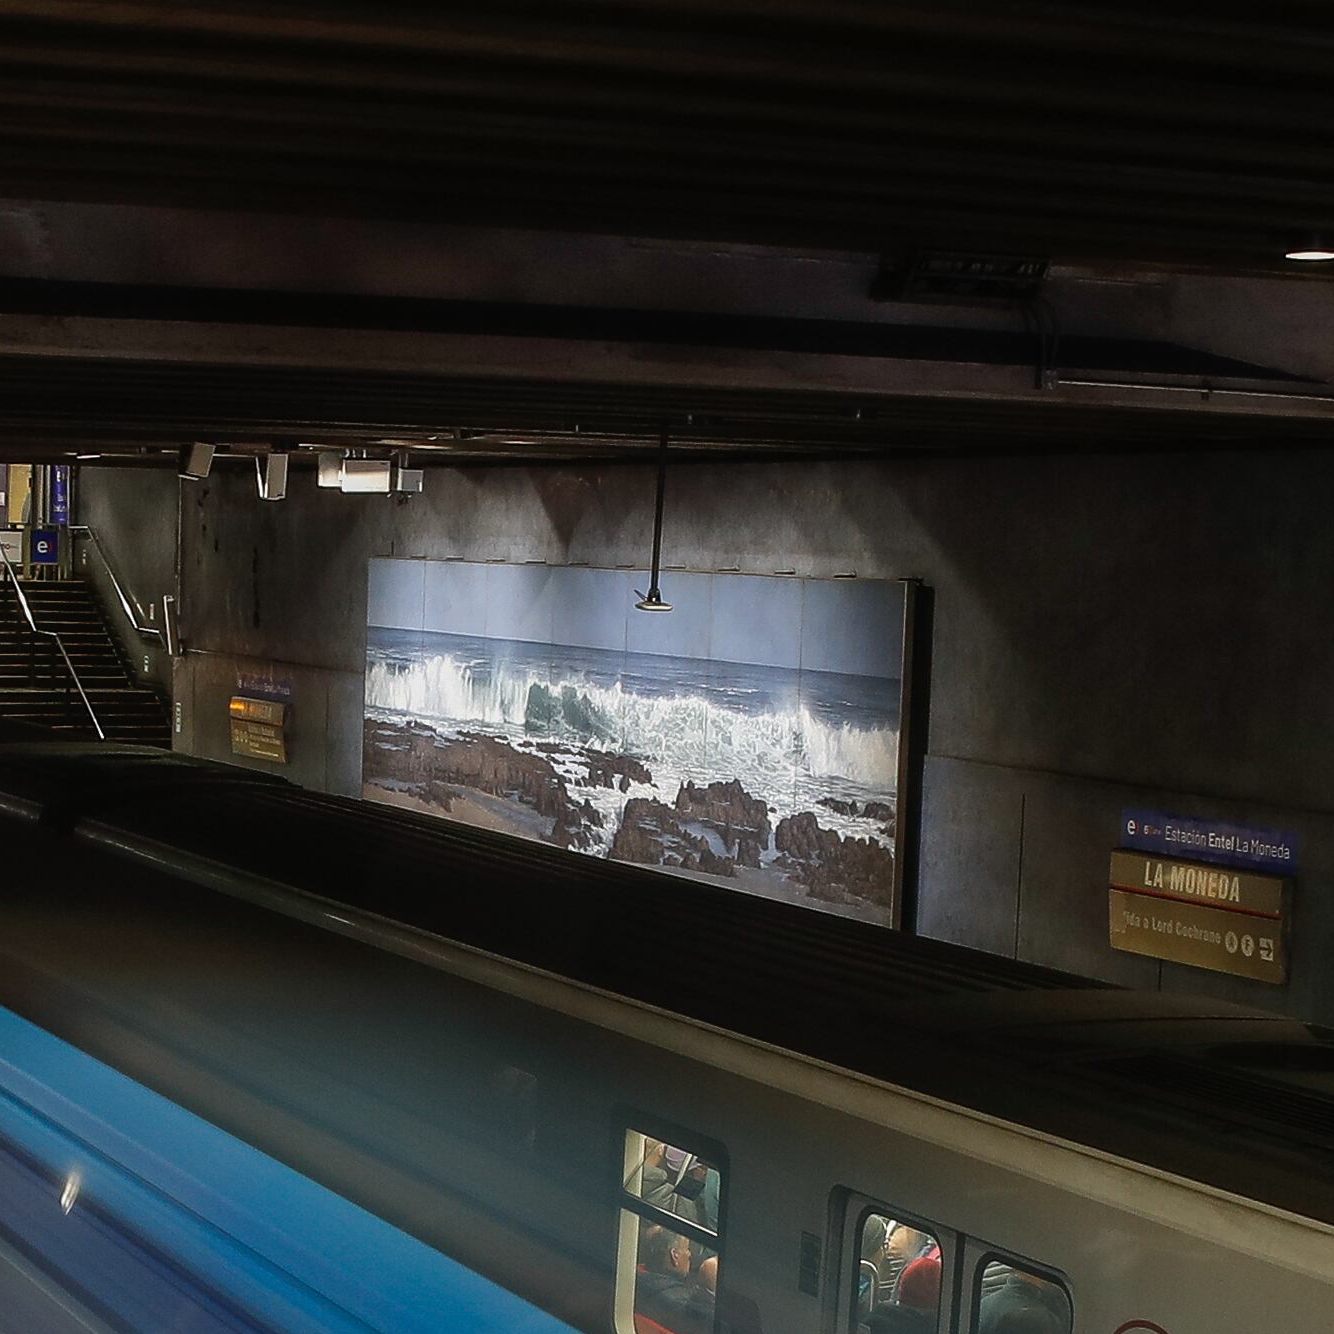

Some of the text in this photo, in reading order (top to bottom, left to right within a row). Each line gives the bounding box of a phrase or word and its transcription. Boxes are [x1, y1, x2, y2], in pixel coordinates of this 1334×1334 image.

[1165, 826, 1207, 846] Estación
[1208, 833, 1234, 851] Entel
[1236, 837, 1249, 853] La
[1250, 839, 1290, 859] Moneda
[1144, 861, 1240, 902] LA MONEDA
